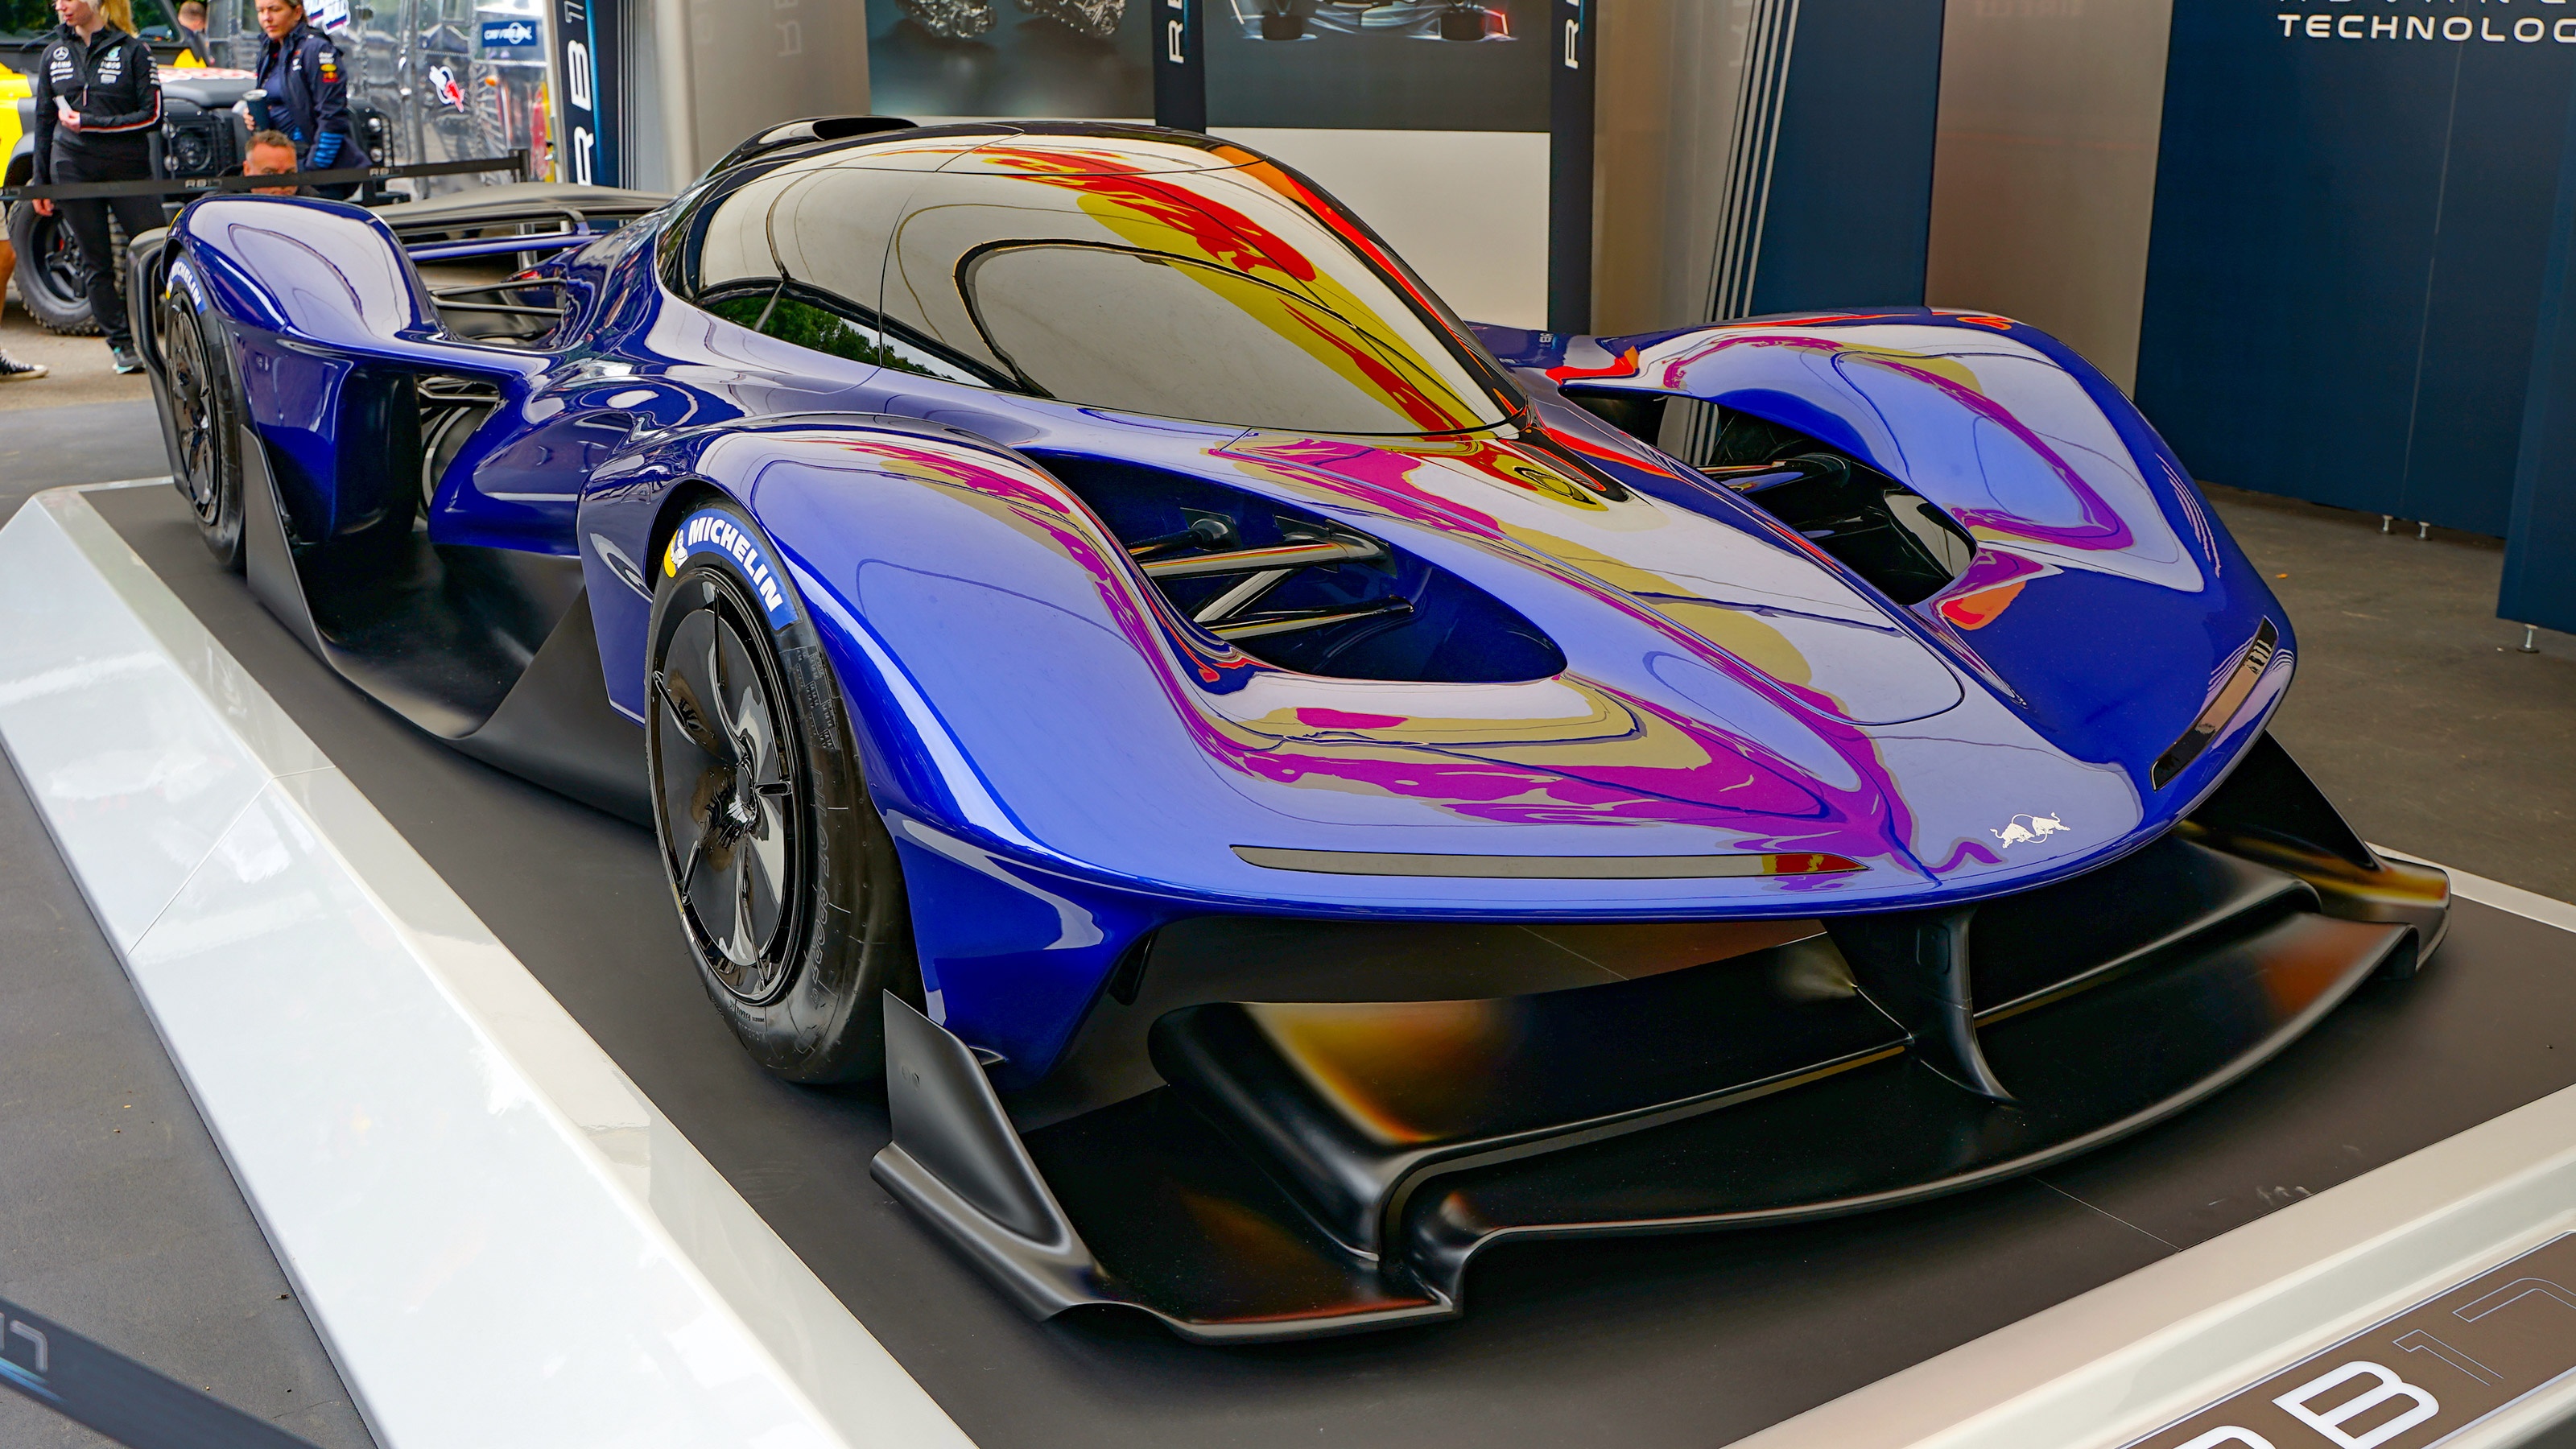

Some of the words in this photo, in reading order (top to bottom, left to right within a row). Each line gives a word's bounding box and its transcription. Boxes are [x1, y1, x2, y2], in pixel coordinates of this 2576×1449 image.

[1564, 0, 1579, 69] R
[2277, 14, 2576, 43] TECHNOLOG
[687, 516, 783, 613] MICHELIN
[808, 879, 829, 985] SPORT
